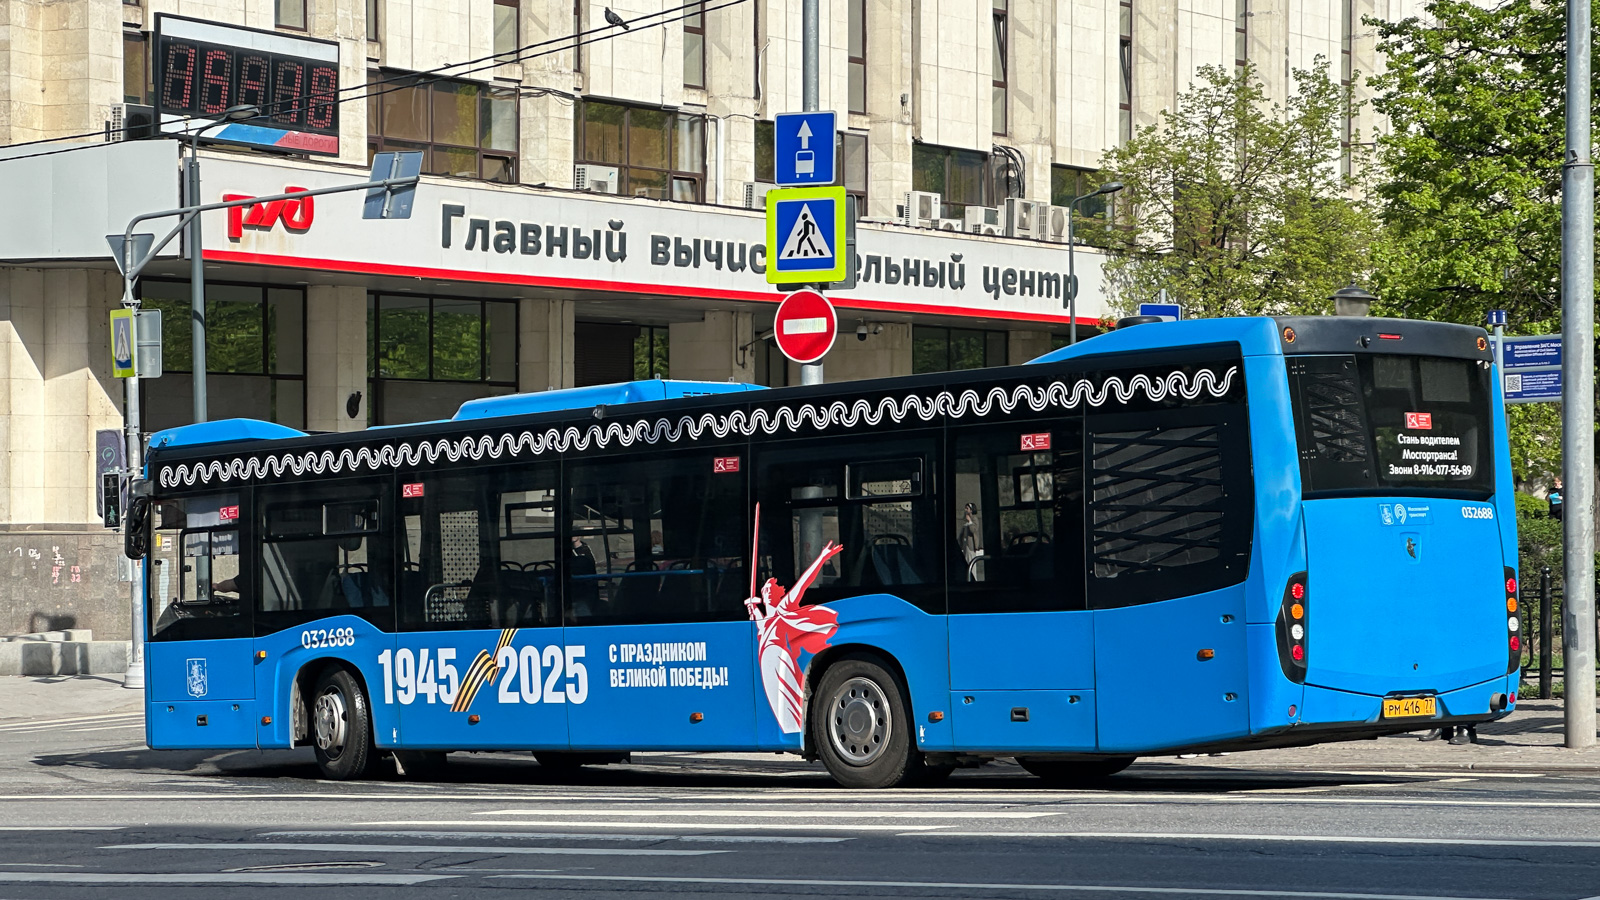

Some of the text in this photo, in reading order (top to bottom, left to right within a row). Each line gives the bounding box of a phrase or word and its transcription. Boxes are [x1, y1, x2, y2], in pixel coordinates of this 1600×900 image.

[442, 203, 627, 263] Главный
[983, 264, 1079, 310] центр
[1397, 433, 1460, 446] Стань водителем
[1402, 449, 1458, 462] Мосгортранса!
[1389, 464, 1472, 475] Звони 8-916-077-56-89
[1461, 506, 1493, 519] 032688
[301, 627, 355, 649] 032688
[609, 642, 706, 665] С ПРАЗДНИКОМ
[378, 645, 588, 705] 1945 2025
[610, 666, 728, 689] ВЕЛИКОЙ ПОБЕДЫ!
[1404, 701, 1420, 714] 416
[1425, 700, 1432, 709] 77
